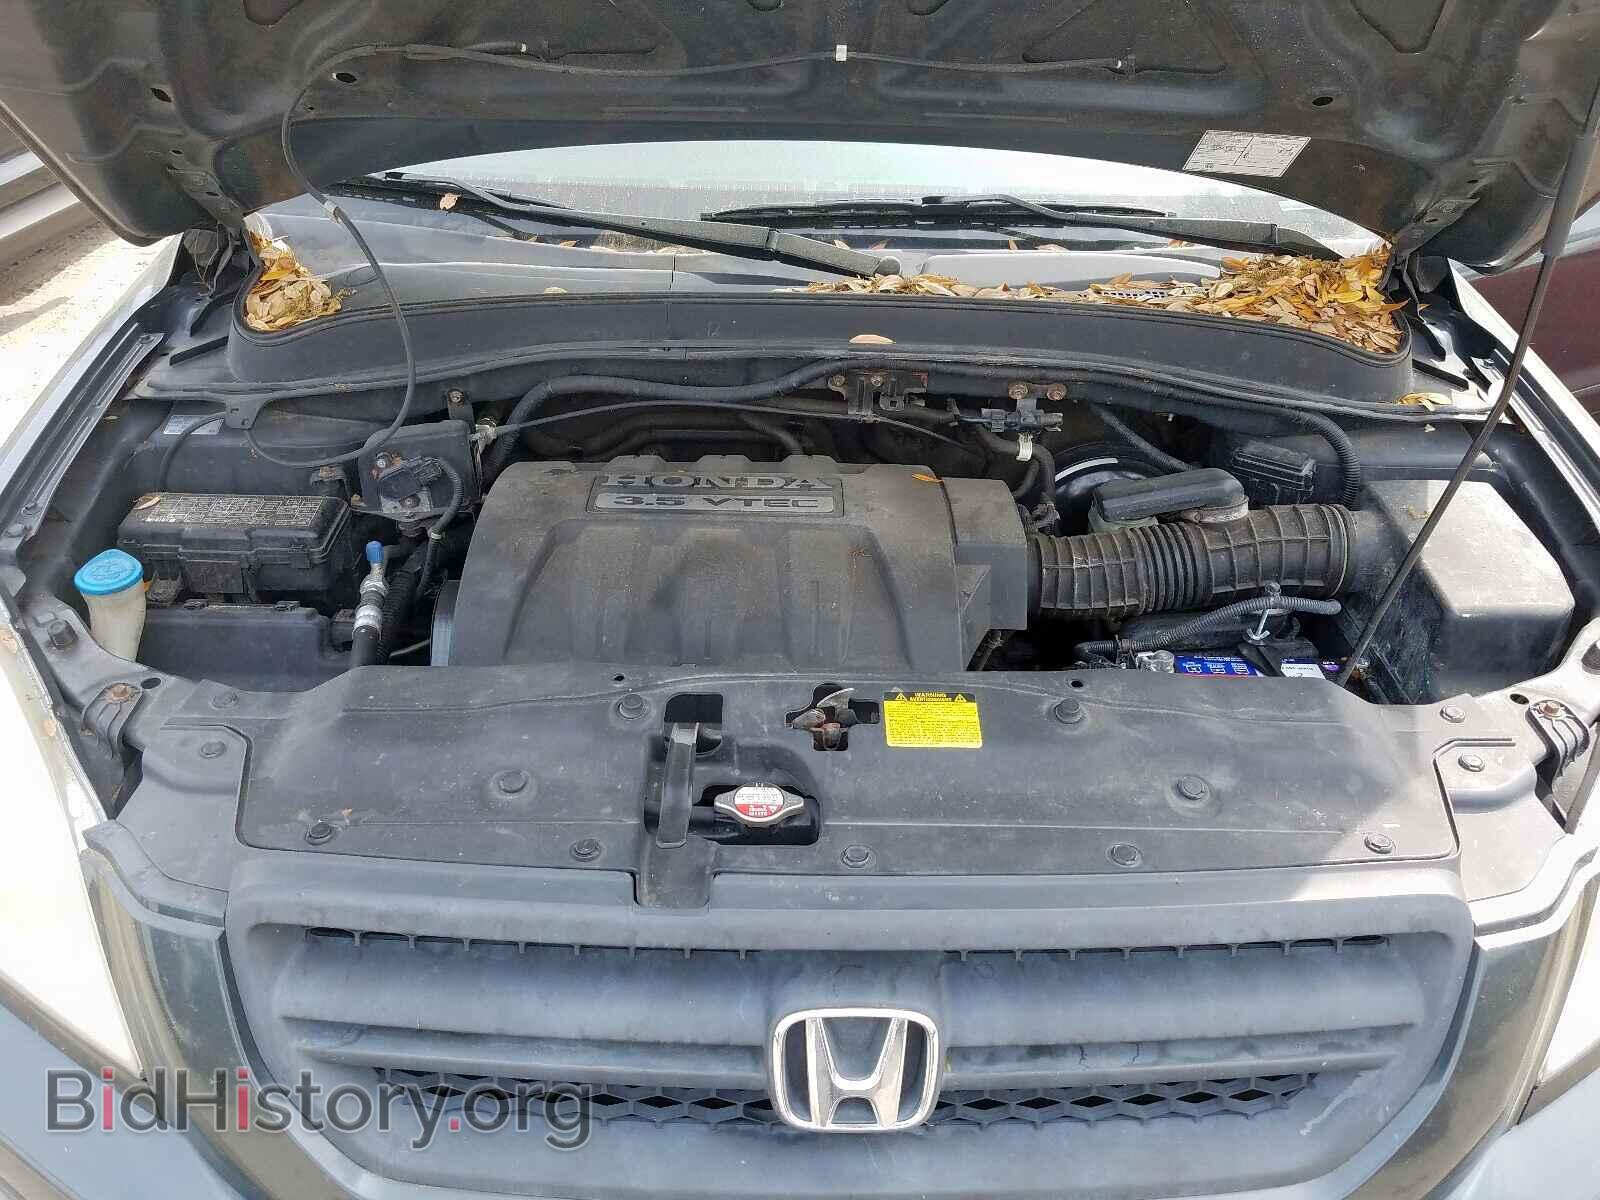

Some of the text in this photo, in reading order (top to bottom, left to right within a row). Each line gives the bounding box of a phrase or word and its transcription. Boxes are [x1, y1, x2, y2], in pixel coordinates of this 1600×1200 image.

[600, 475, 833, 488] HONDA
[613, 496, 818, 508] 3.5 VTEC
